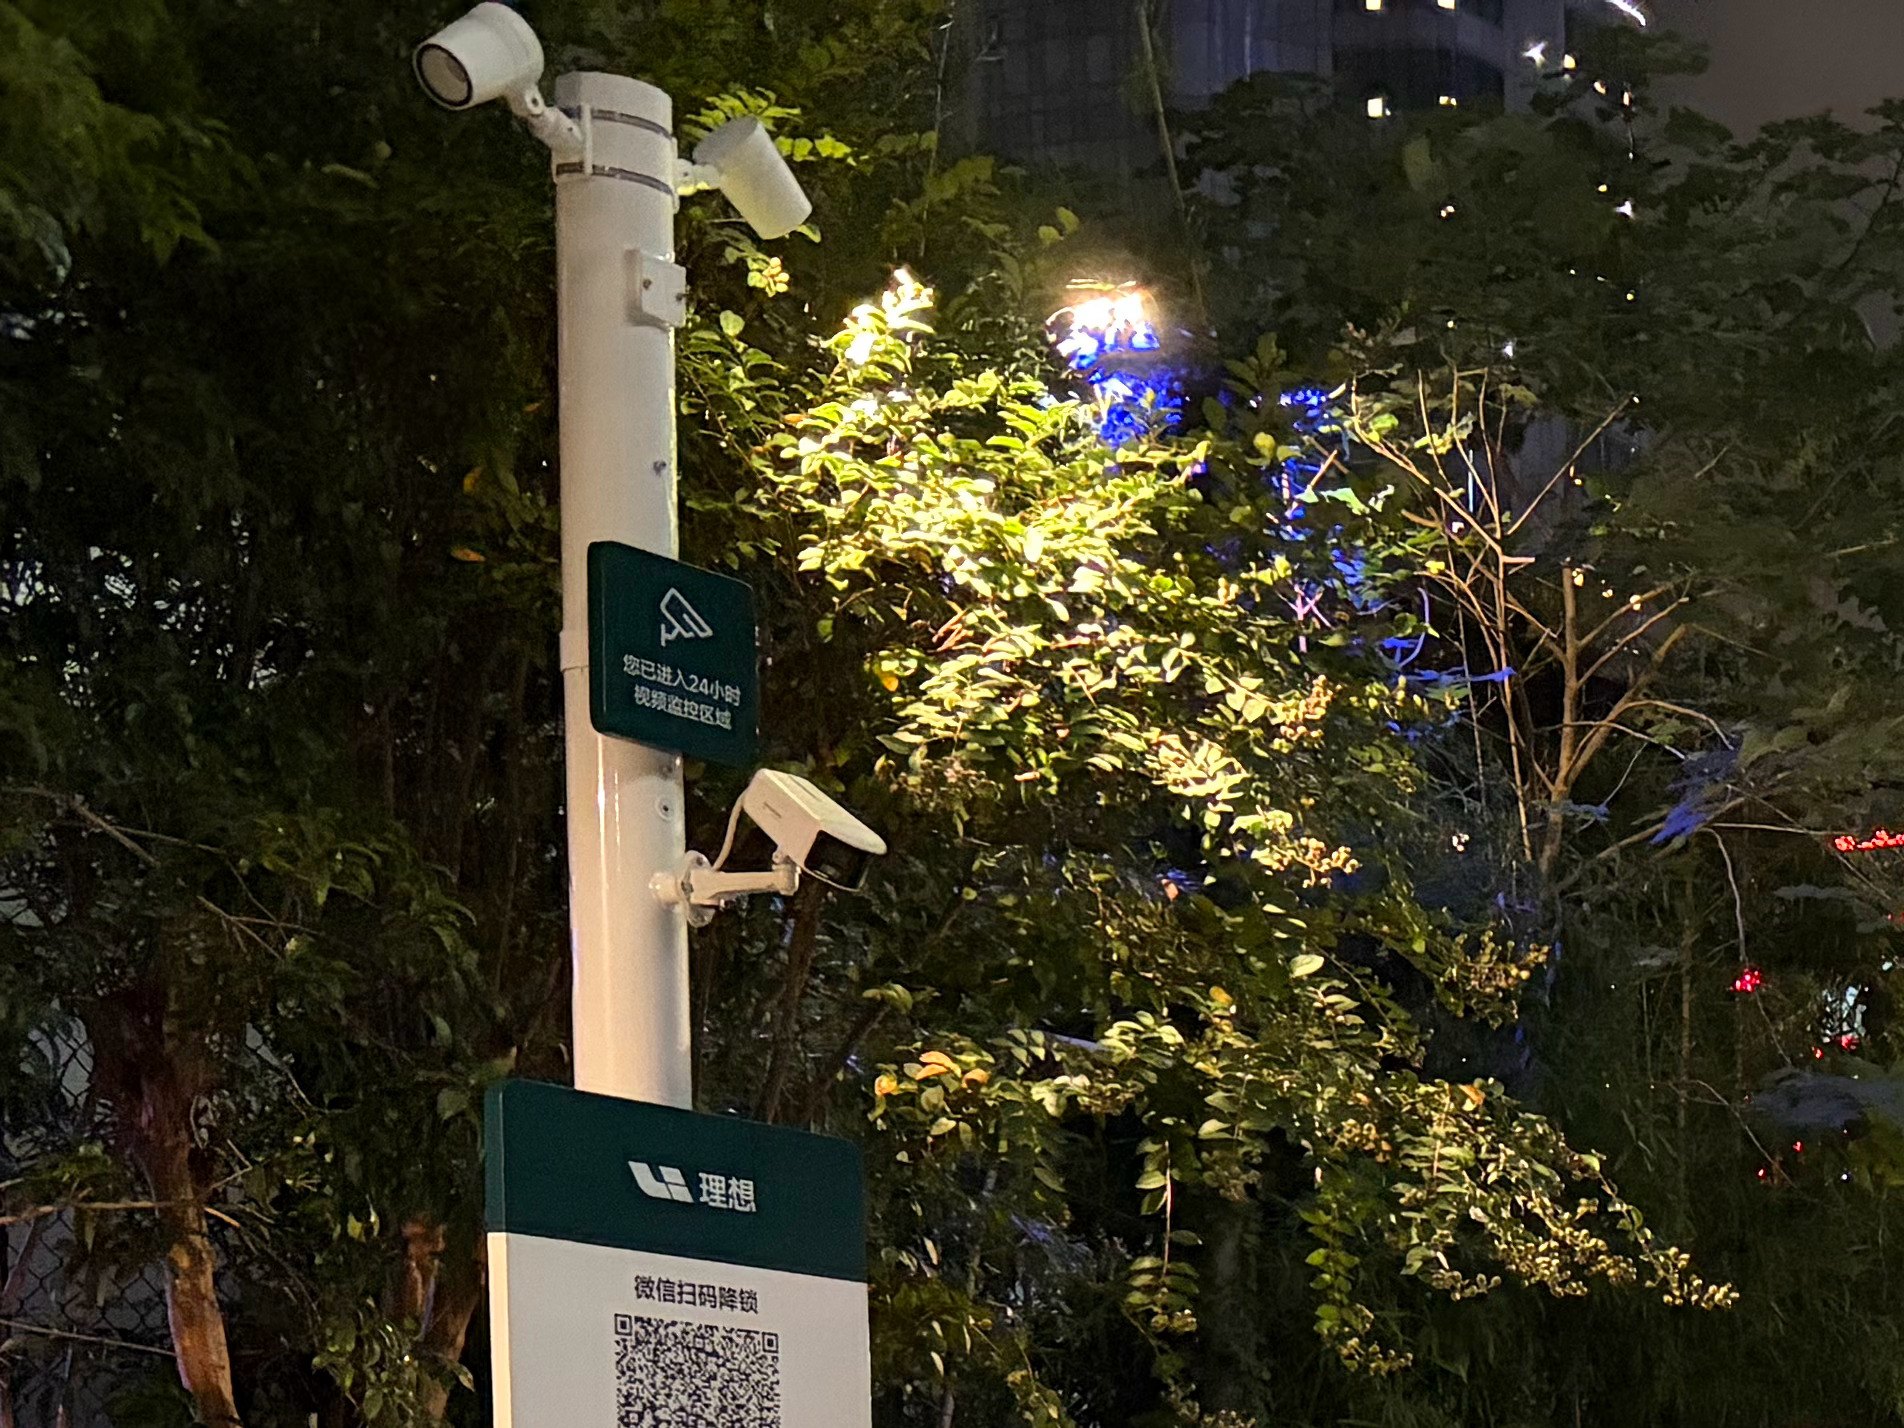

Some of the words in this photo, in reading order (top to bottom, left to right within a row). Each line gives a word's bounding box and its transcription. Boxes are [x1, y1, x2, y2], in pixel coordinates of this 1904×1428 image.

[623, 654, 741, 707] 您已进入24小时
[634, 685, 732, 731] 视频监控区域
[698, 1171, 757, 1212] 理想
[634, 1275, 759, 1315] 微信扫码降锁
